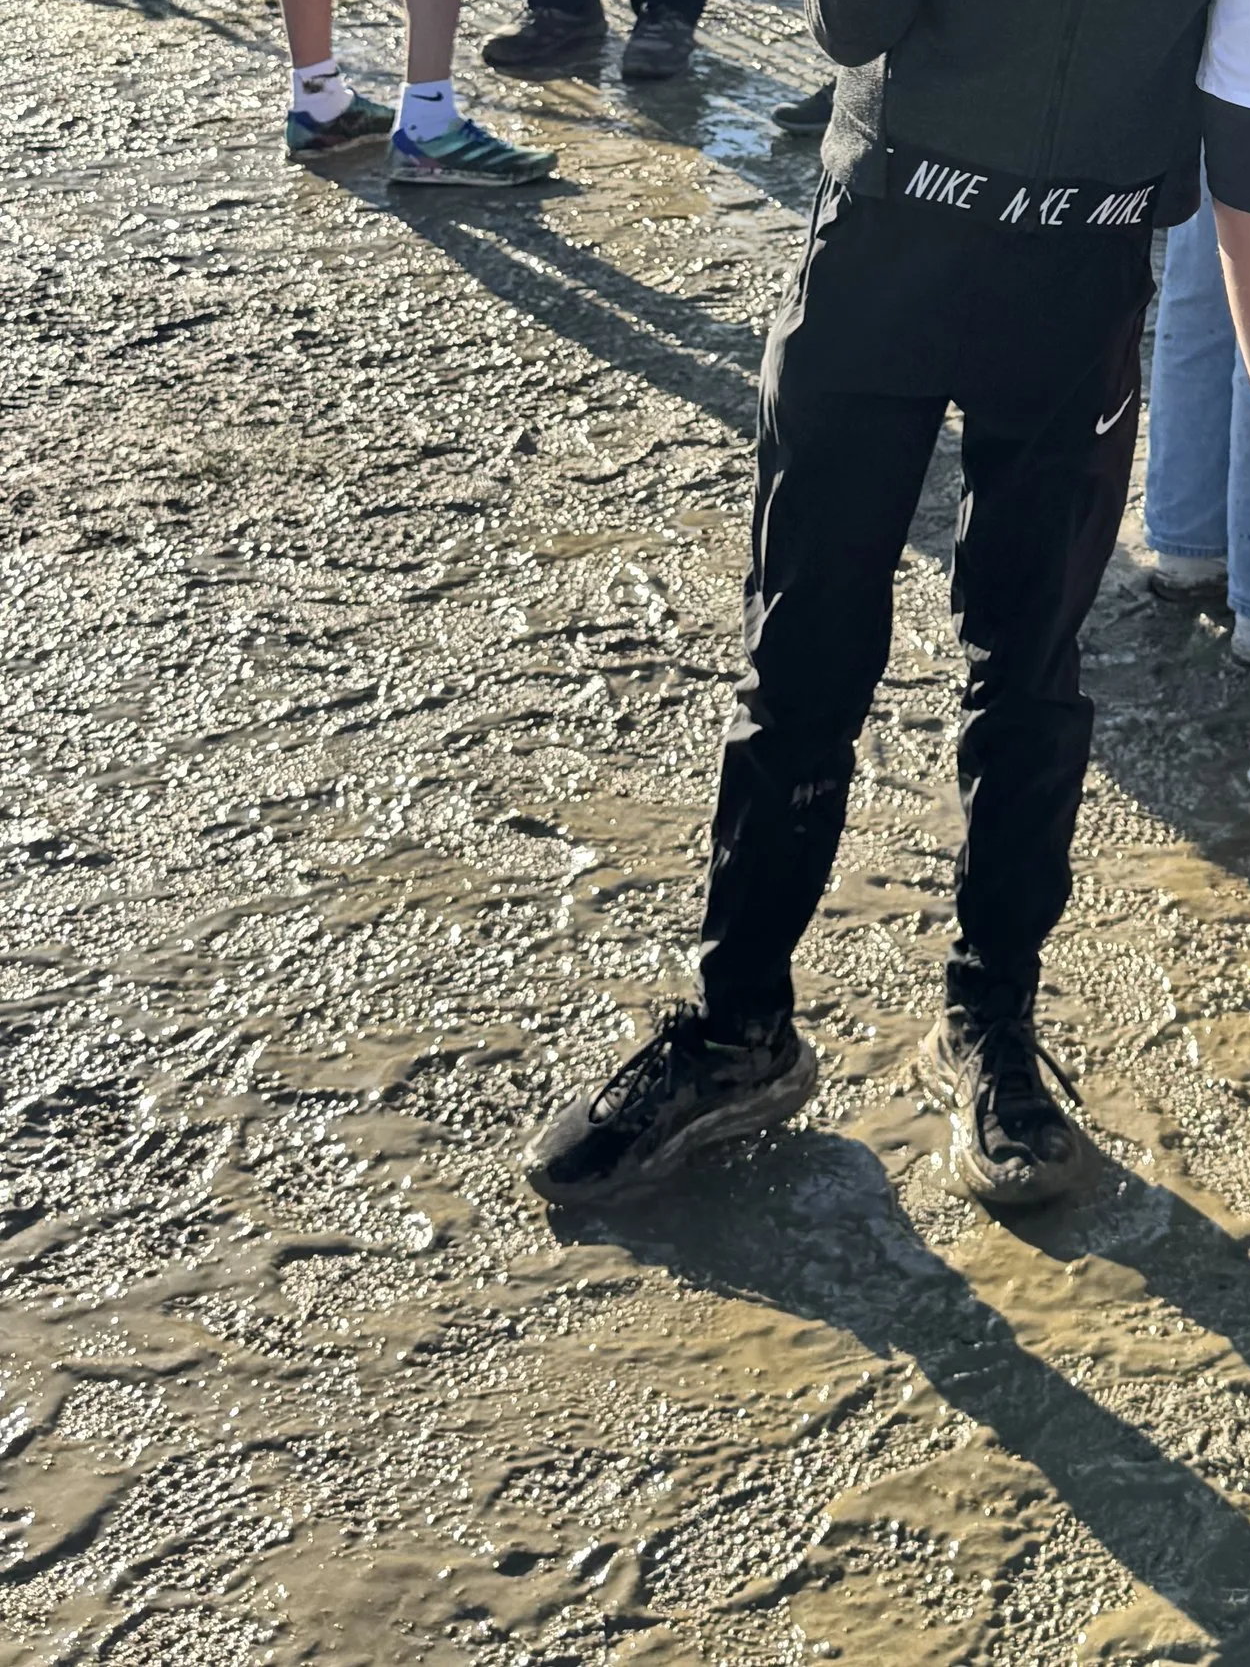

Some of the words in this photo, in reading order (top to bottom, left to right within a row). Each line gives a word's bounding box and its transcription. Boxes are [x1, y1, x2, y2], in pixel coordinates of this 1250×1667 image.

[904, 160, 988, 210] NIKE
[999, 187, 1079, 225] NKE
[1086, 185, 1154, 226] NIKE
